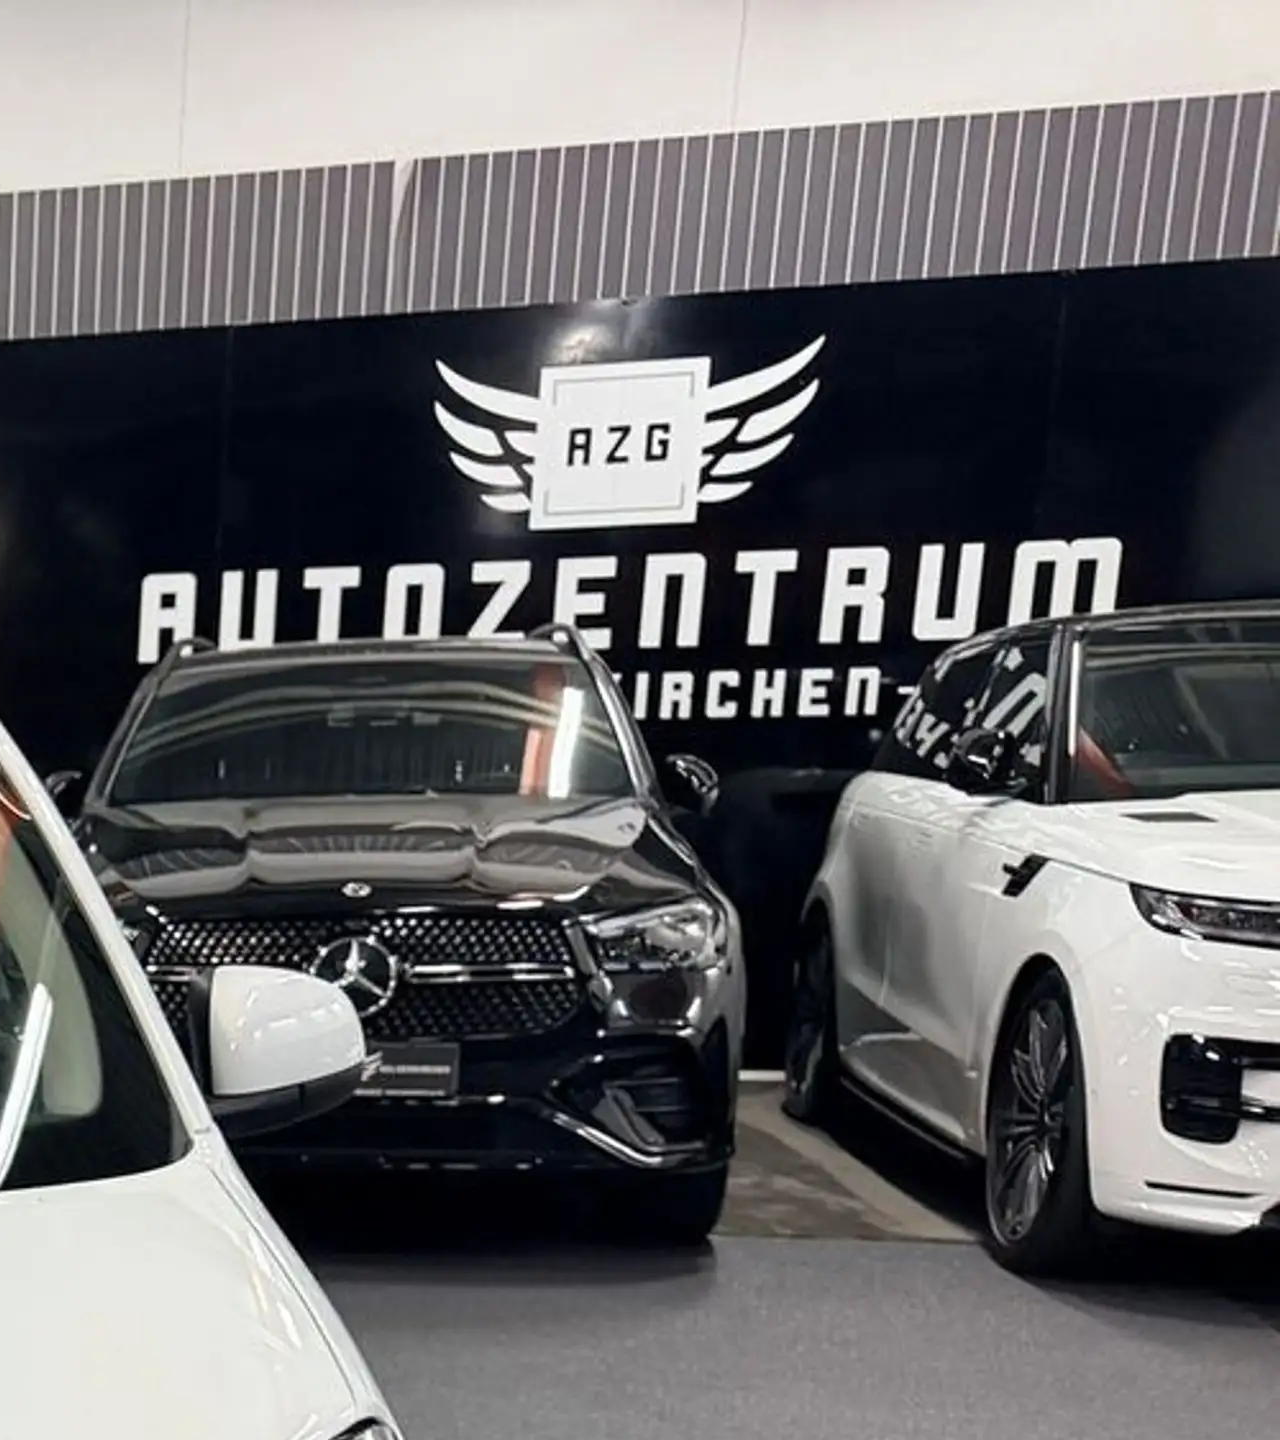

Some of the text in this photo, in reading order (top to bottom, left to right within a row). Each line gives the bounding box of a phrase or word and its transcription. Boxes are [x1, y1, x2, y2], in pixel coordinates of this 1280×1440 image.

[567, 422, 671, 467] AZG
[138, 537, 1123, 664] AUTOZENTRUM
[611, 667, 882, 719] IRCHEN
